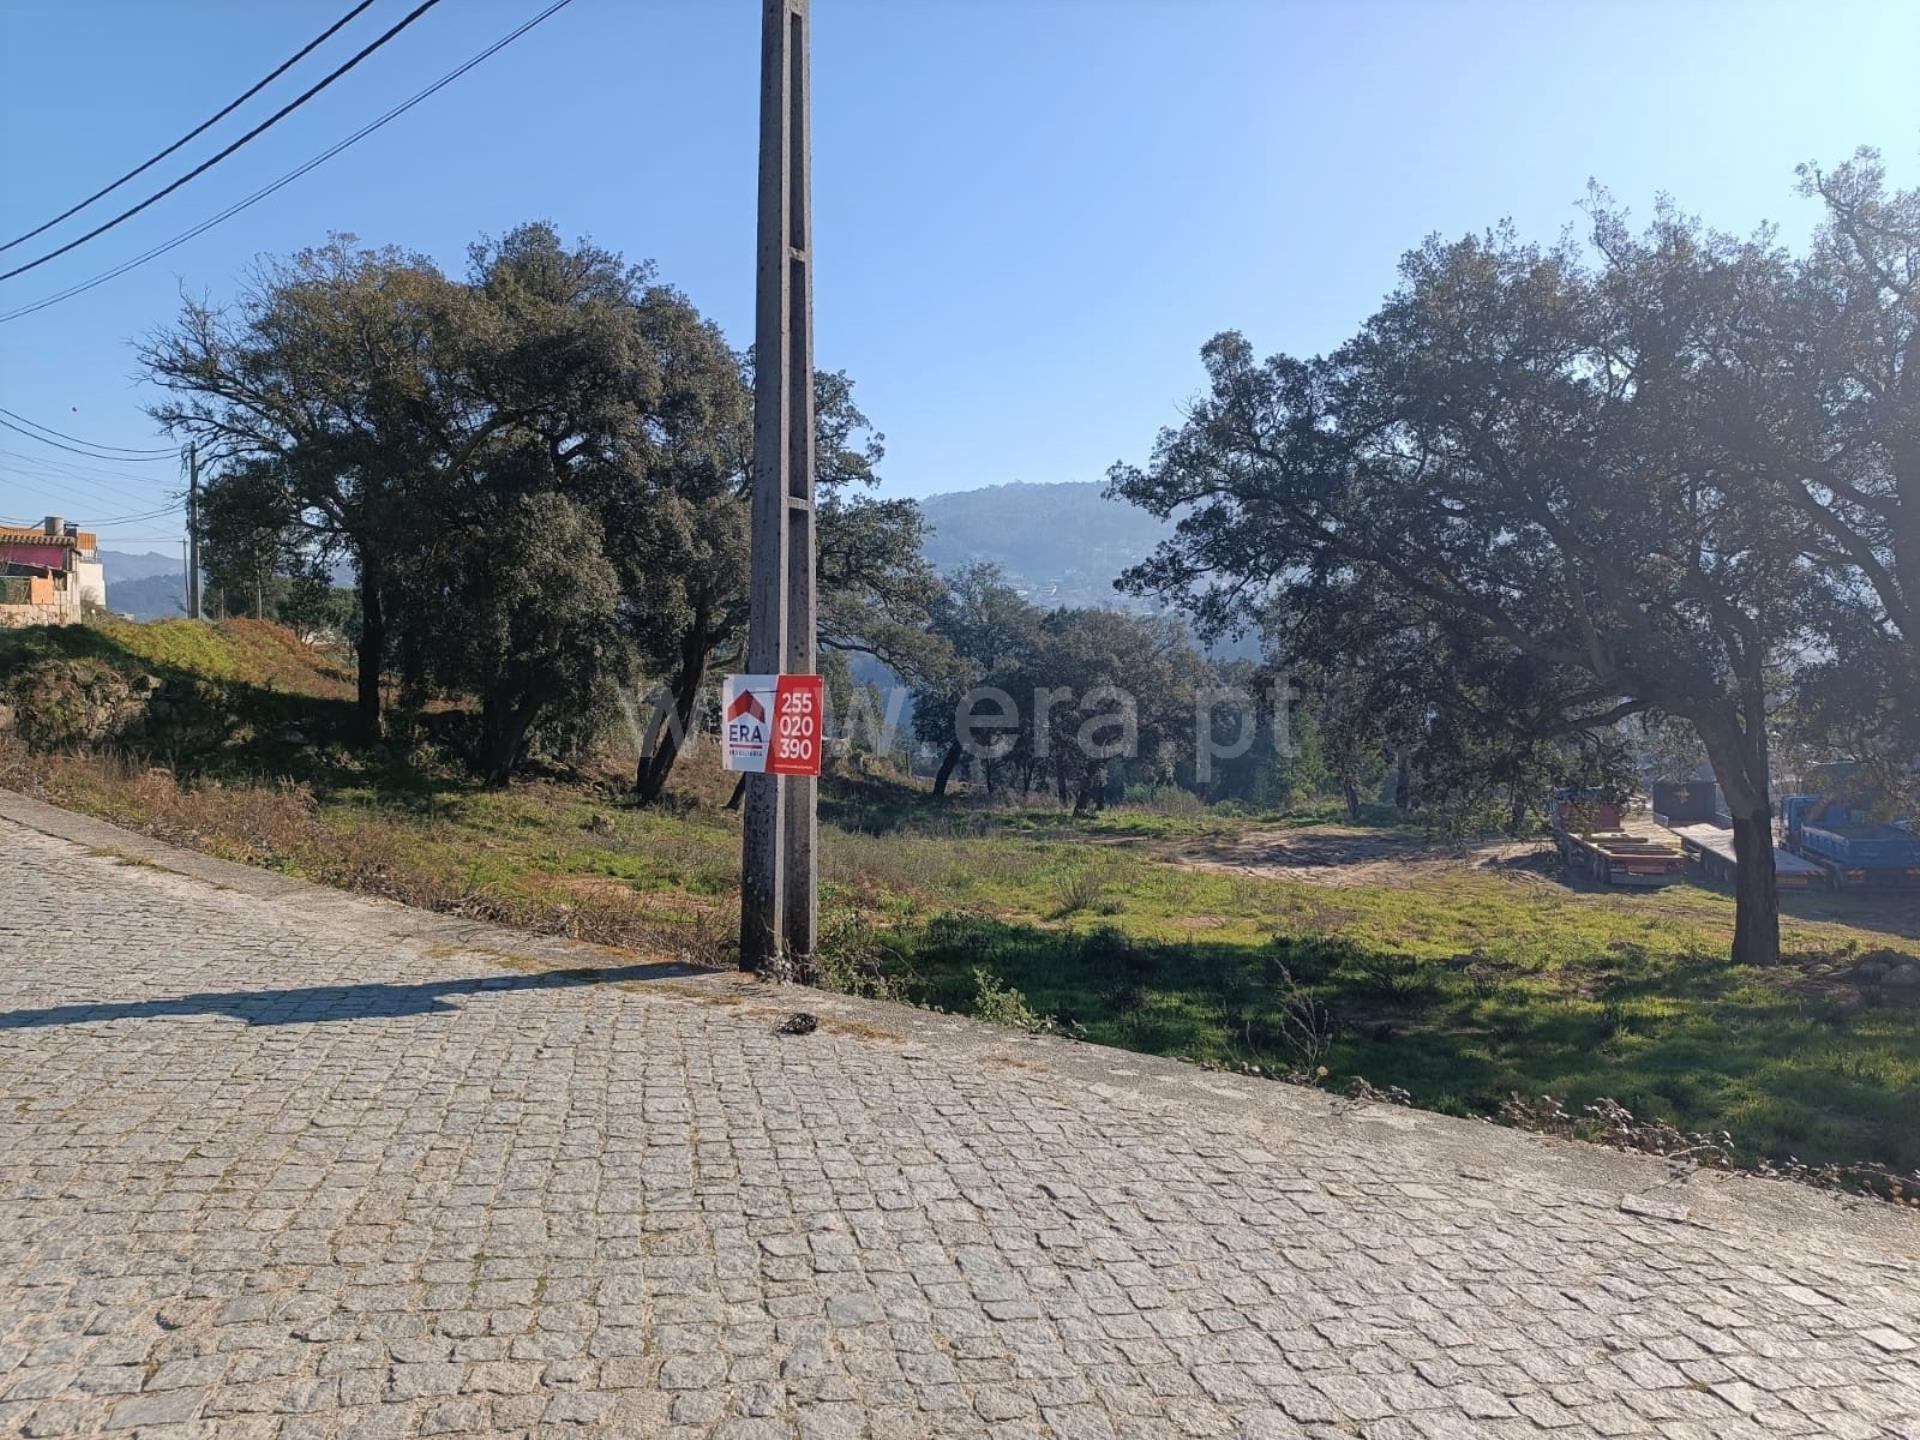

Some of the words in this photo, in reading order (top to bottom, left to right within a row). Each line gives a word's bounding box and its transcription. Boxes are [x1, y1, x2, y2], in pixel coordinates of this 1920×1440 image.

[781, 692, 813, 714] 255
[728, 724, 763, 743] ERA
[780, 715, 814, 737] 020
[779, 738, 813, 760] 390
